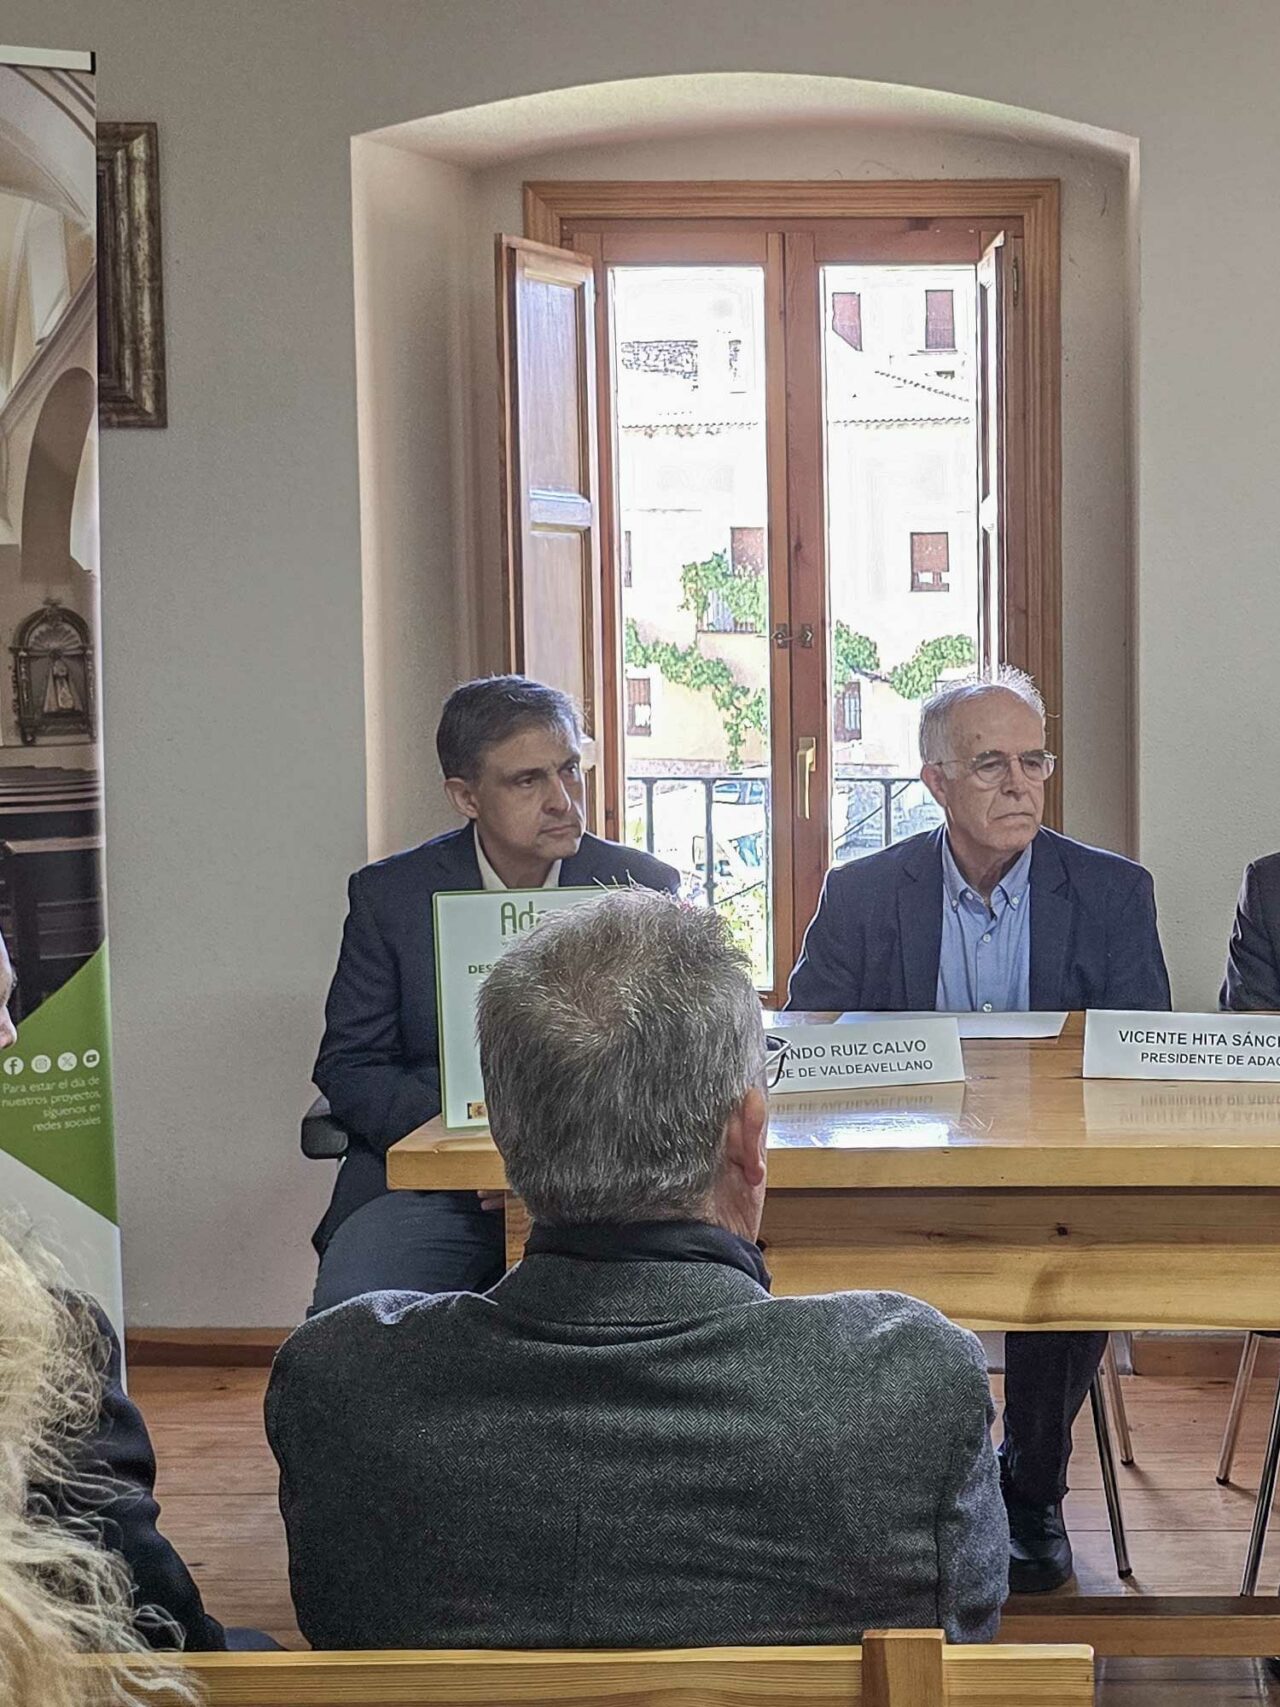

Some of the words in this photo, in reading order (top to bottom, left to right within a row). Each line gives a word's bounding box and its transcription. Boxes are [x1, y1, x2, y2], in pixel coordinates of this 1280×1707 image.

[501, 900, 547, 936] Ad
[1118, 1030, 1187, 1046] VICENTE
[1192, 1032, 1227, 1047] HITA
[831, 1043, 869, 1057] RUIZ
[872, 1039, 927, 1054] CALVO
[1140, 1052, 1223, 1065] PRESIDENTE
[1227, 1054, 1244, 1066] DE
[798, 1067, 817, 1078] DE
[820, 1059, 934, 1076] VALDEAVELLANO
[3, 1082, 27, 1094] Para
[29, 1081, 56, 1092] estar
[58, 1078, 68, 1089] el
[88, 1076, 100, 1086] de
[2, 1096, 48, 1107] nuestros
[89, 1103, 100, 1112] en
[33, 1121, 61, 1132] redes
[65, 1117, 101, 1129] sociales
